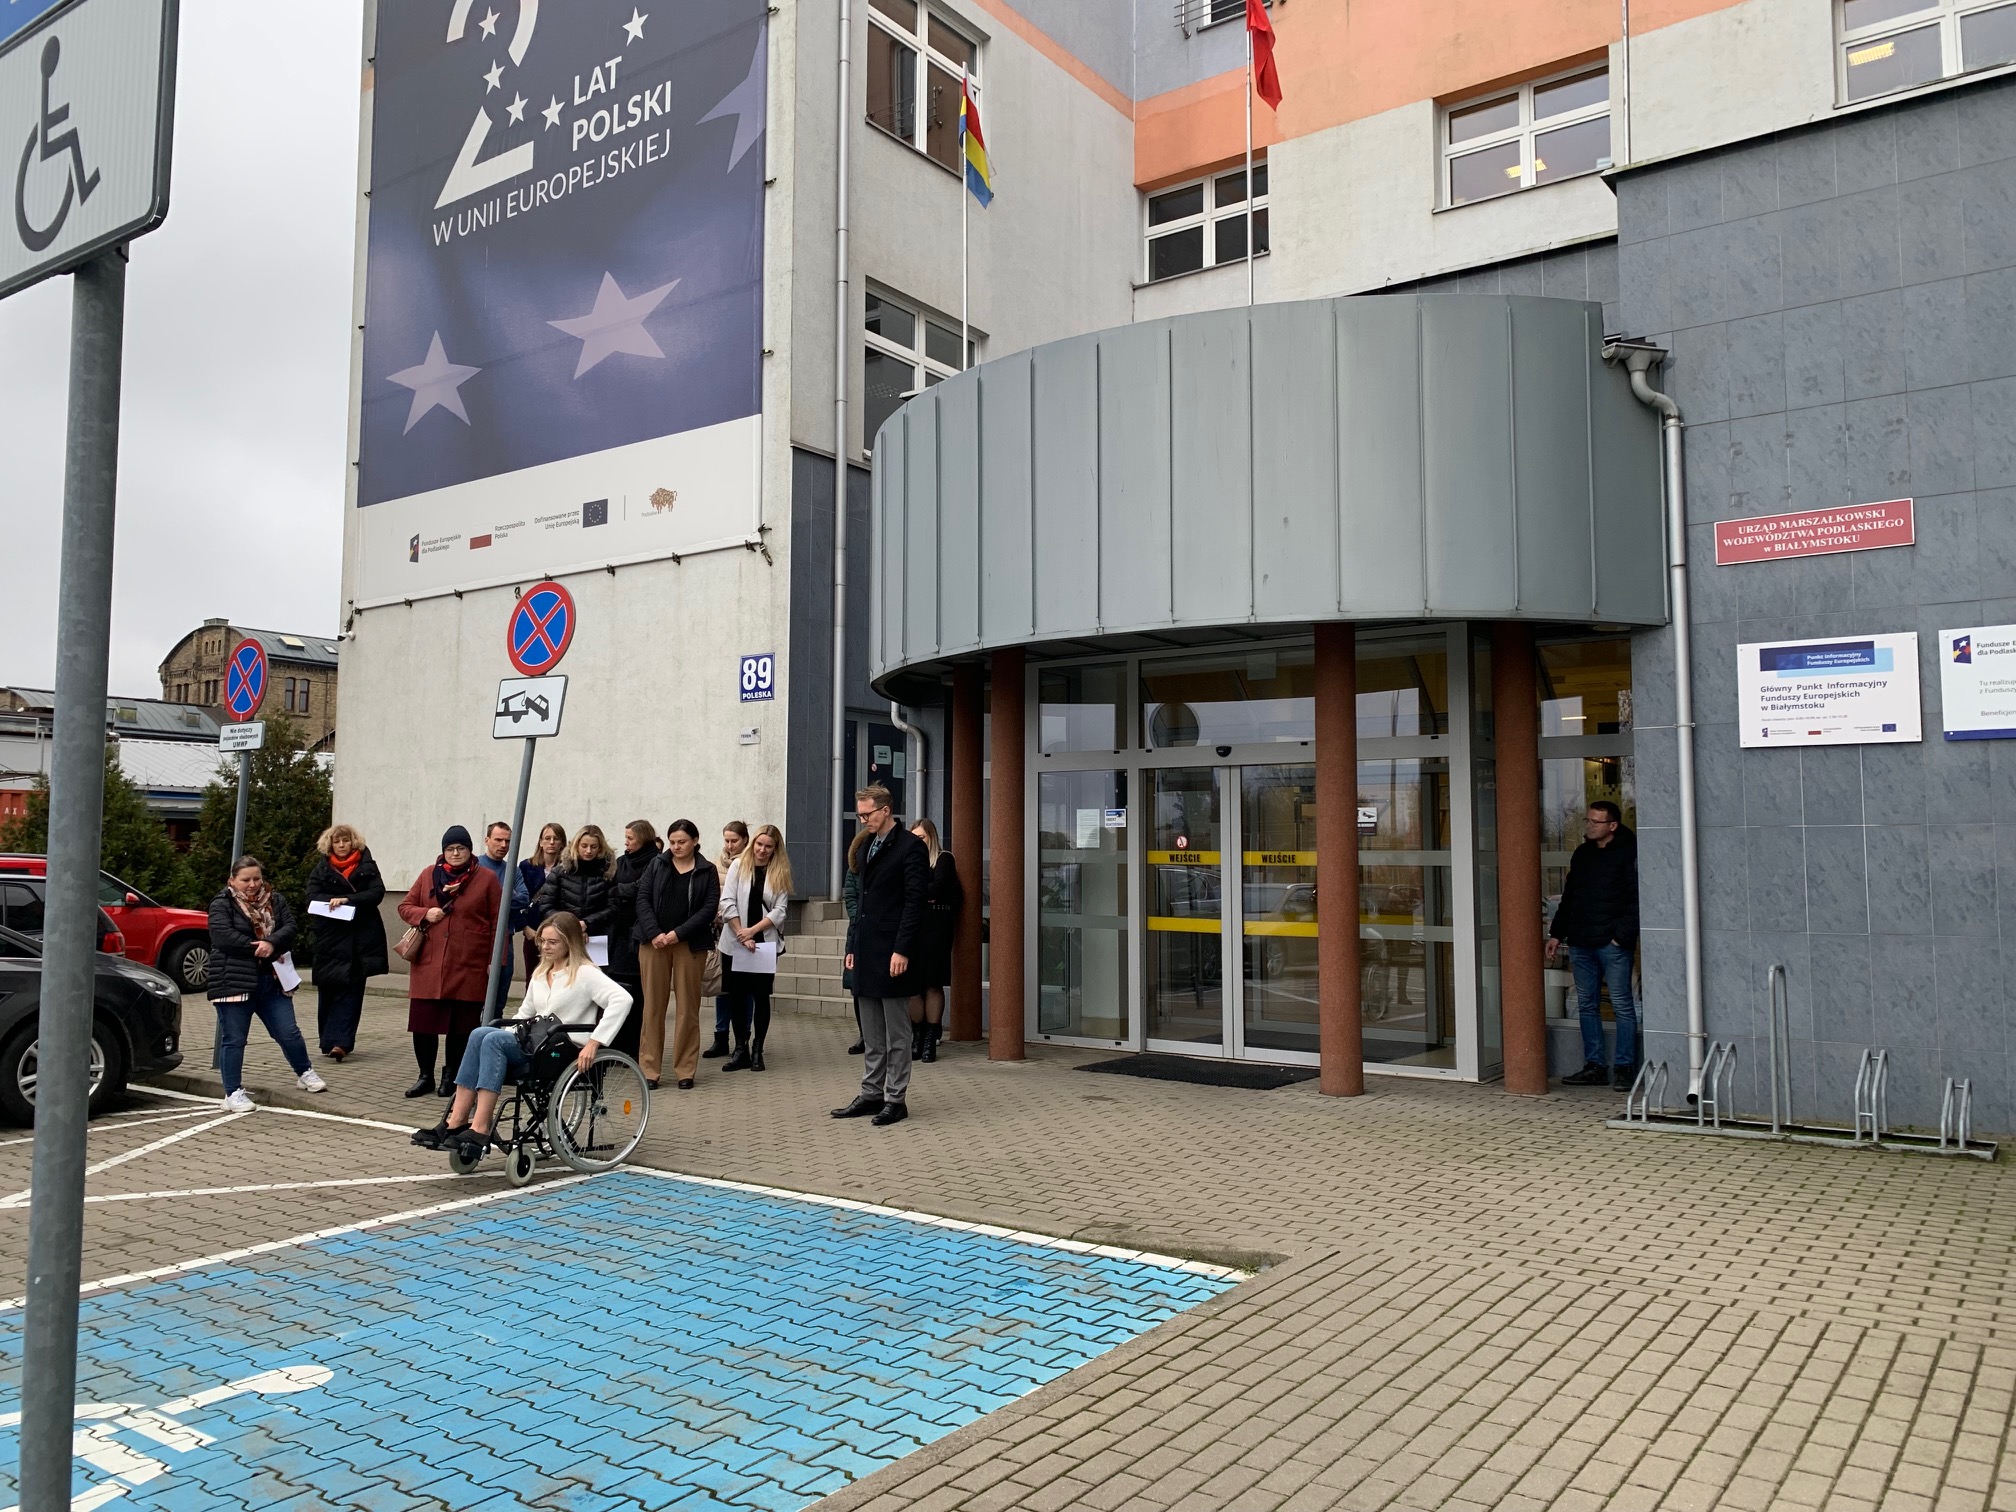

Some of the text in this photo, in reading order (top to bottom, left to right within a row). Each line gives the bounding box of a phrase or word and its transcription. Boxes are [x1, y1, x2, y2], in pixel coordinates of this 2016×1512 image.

[572, 55, 623, 107] LAT
[572, 80, 672, 152] POLSKI
[432, 128, 671, 247] W UNII EUROPEJSKIEJ
[1738, 508, 1887, 535] URZĄD MARSZAŁKOWSKI
[494, 531, 509, 540] Polska
[1722, 517, 1905, 547] WOJEWÓDZTWA PODLASKIEGO
[1763, 535, 1861, 553] w BIAŁYMSTOKU
[1976, 641, 2011, 649] Fundusze
[742, 657, 772, 691] 89
[1760, 680, 1888, 694] Główny Punkt Informacyjny
[742, 690, 772, 700] POLESKA
[1760, 690, 1861, 703] Funduszy Europejskich
[1770, 702, 1825, 712] Białymstoku
[1168, 851, 1202, 863] WEJŚCIE
[1261, 852, 1297, 864] WEJŚCIE
